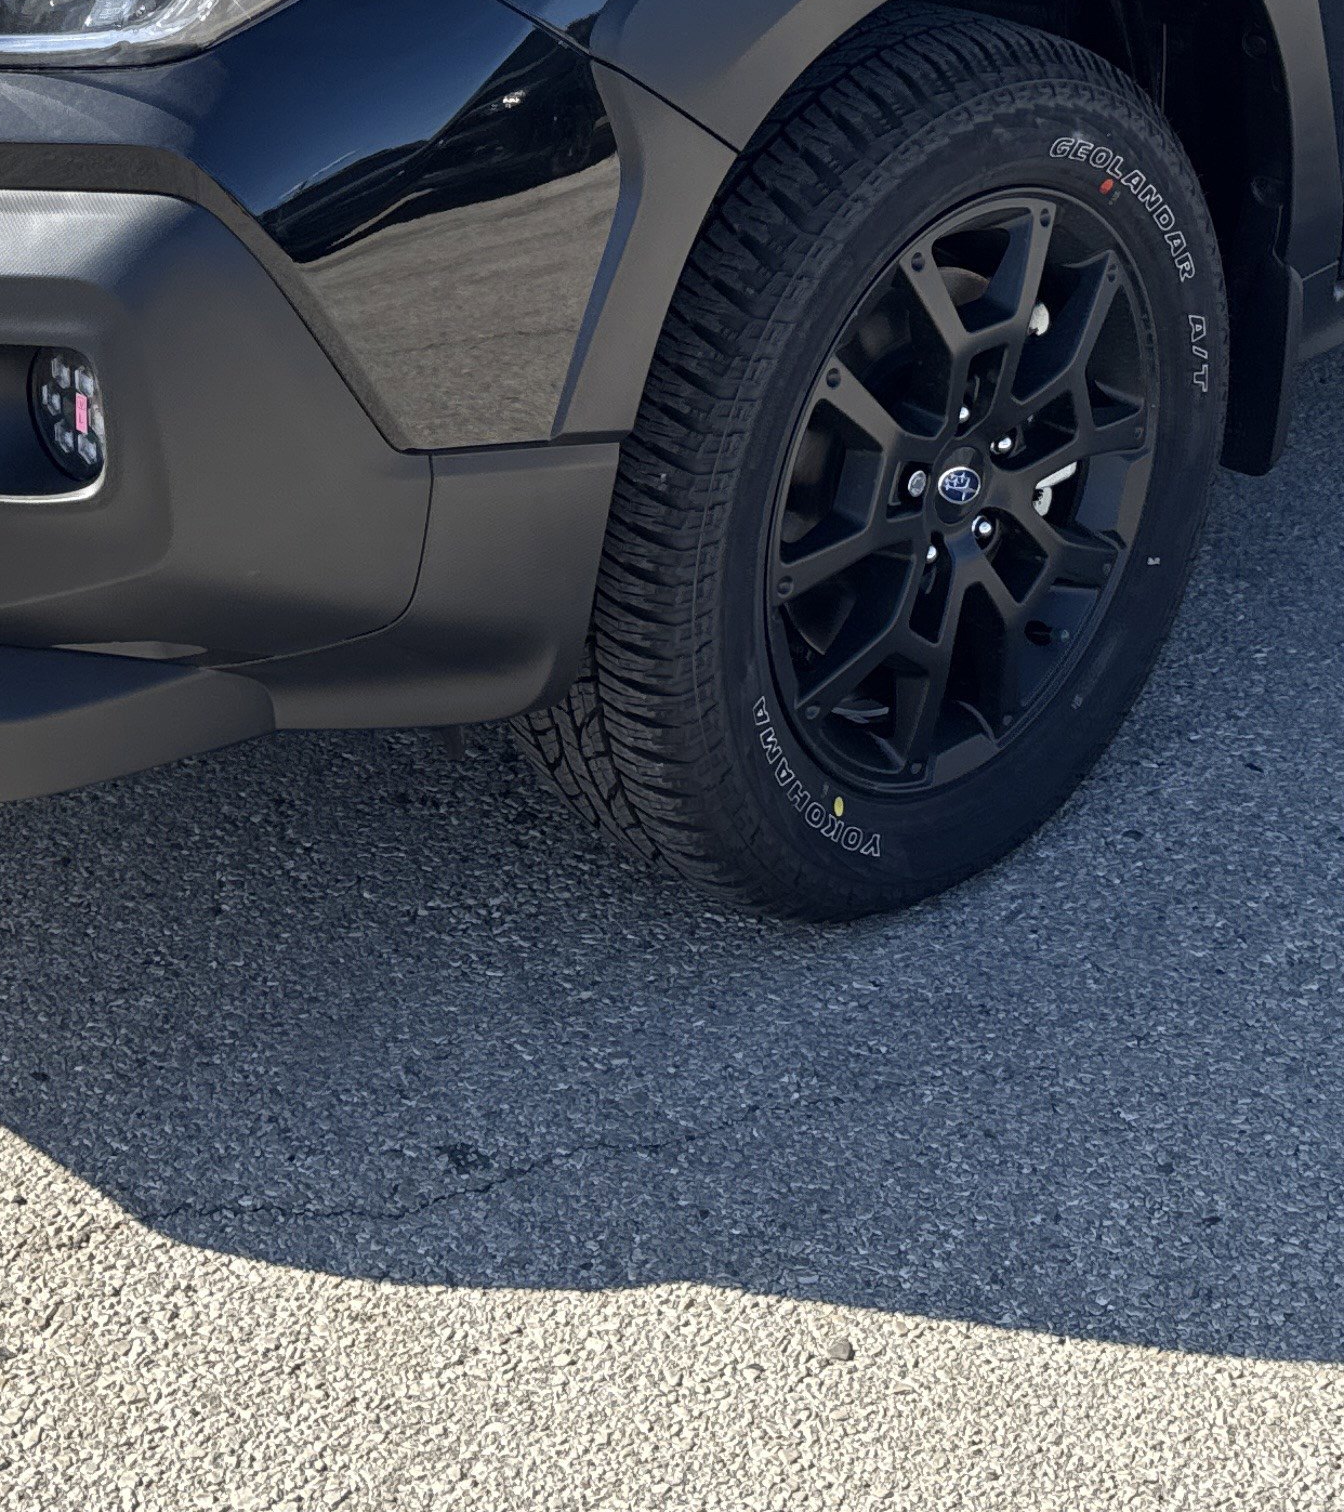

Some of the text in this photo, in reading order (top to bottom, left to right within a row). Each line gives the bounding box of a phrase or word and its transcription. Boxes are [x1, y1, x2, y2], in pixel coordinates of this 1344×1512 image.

[1049, 137, 1208, 393] GEOLANDAR A/T
[753, 695, 881, 857] YOKOHAMA
